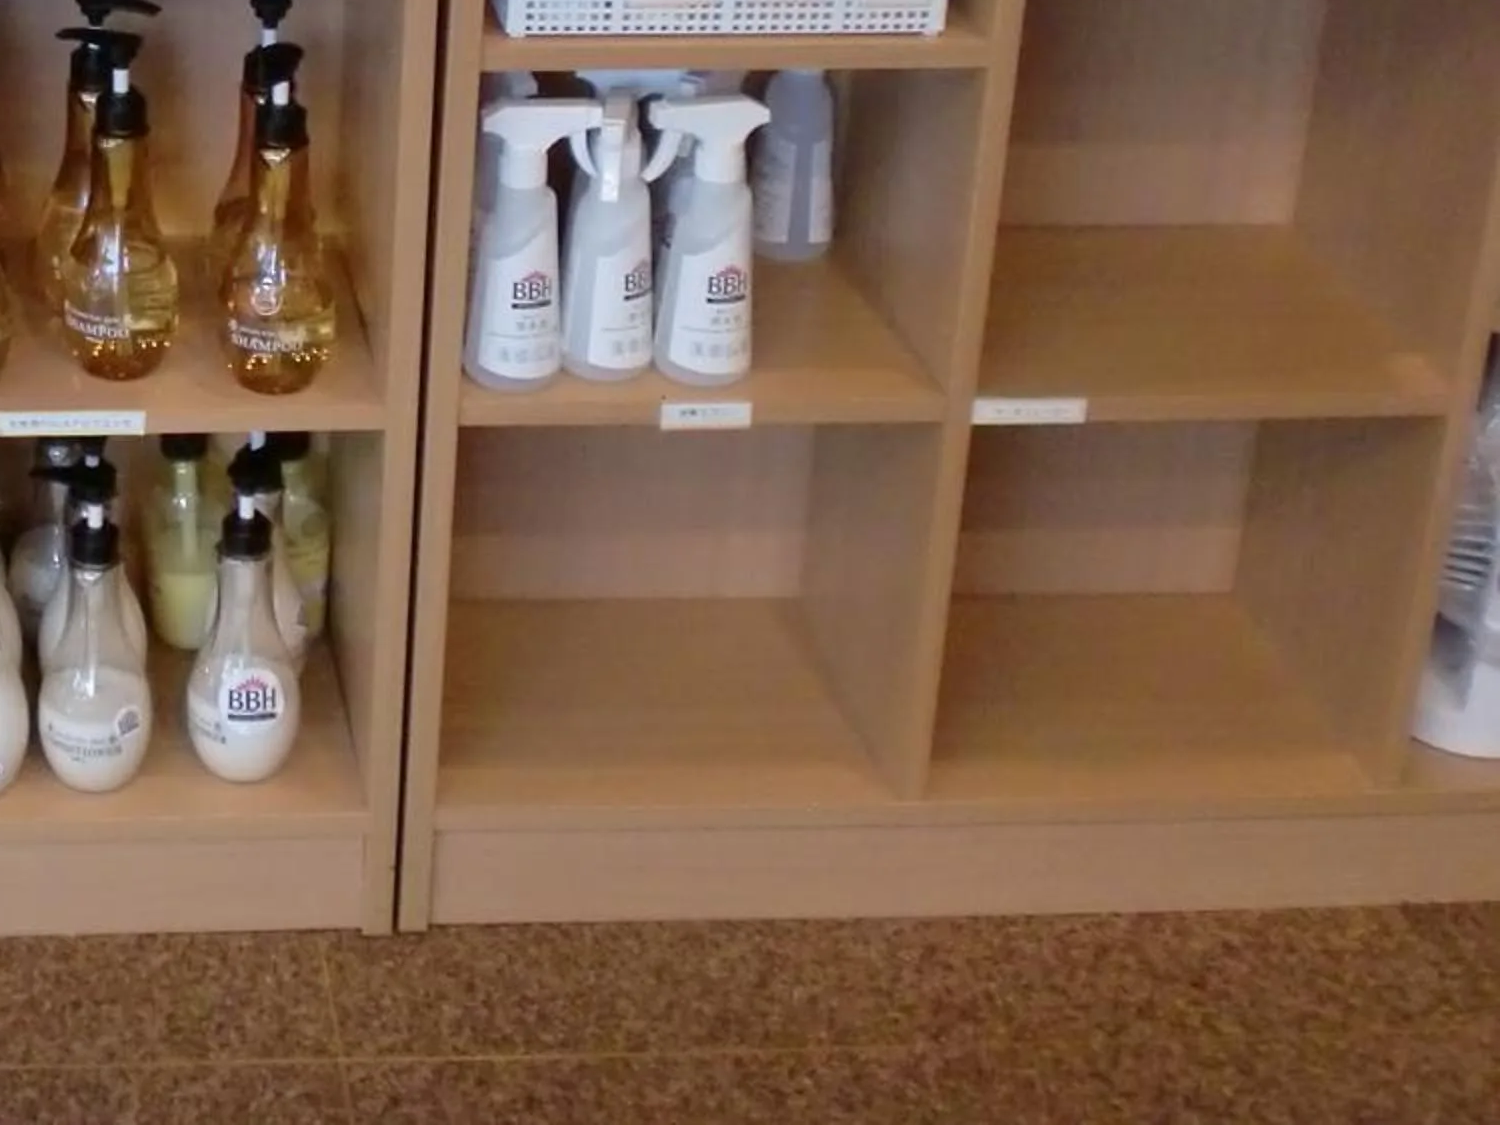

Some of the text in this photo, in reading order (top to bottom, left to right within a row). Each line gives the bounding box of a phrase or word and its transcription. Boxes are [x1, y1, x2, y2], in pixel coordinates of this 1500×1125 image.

[512, 279, 553, 301] BBH
[706, 273, 748, 296] BBH
[228, 687, 277, 713] BBH
